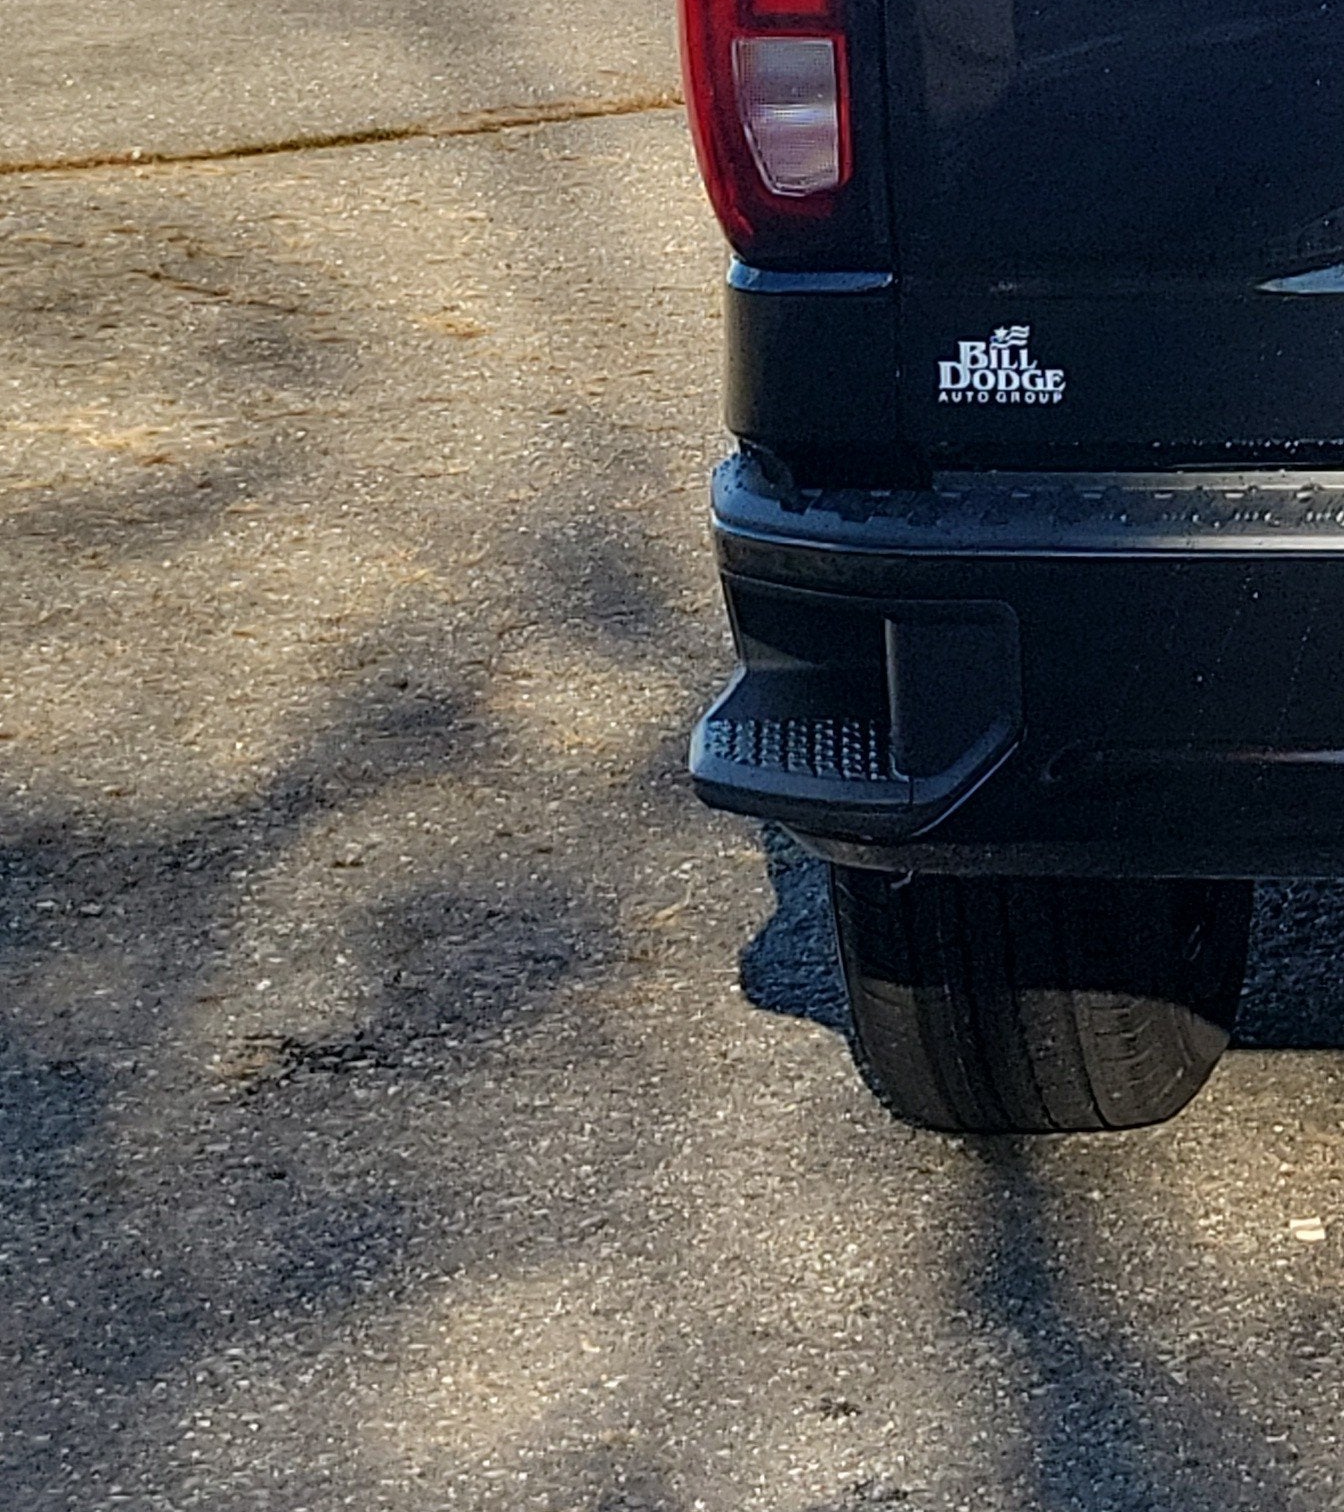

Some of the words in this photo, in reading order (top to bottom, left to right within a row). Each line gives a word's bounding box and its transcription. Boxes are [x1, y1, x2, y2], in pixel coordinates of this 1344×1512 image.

[957, 340, 1038, 370] BILL
[937, 361, 1067, 392] DODGE
[938, 391, 989, 403] AUTO
[995, 391, 1063, 404] GROUP
